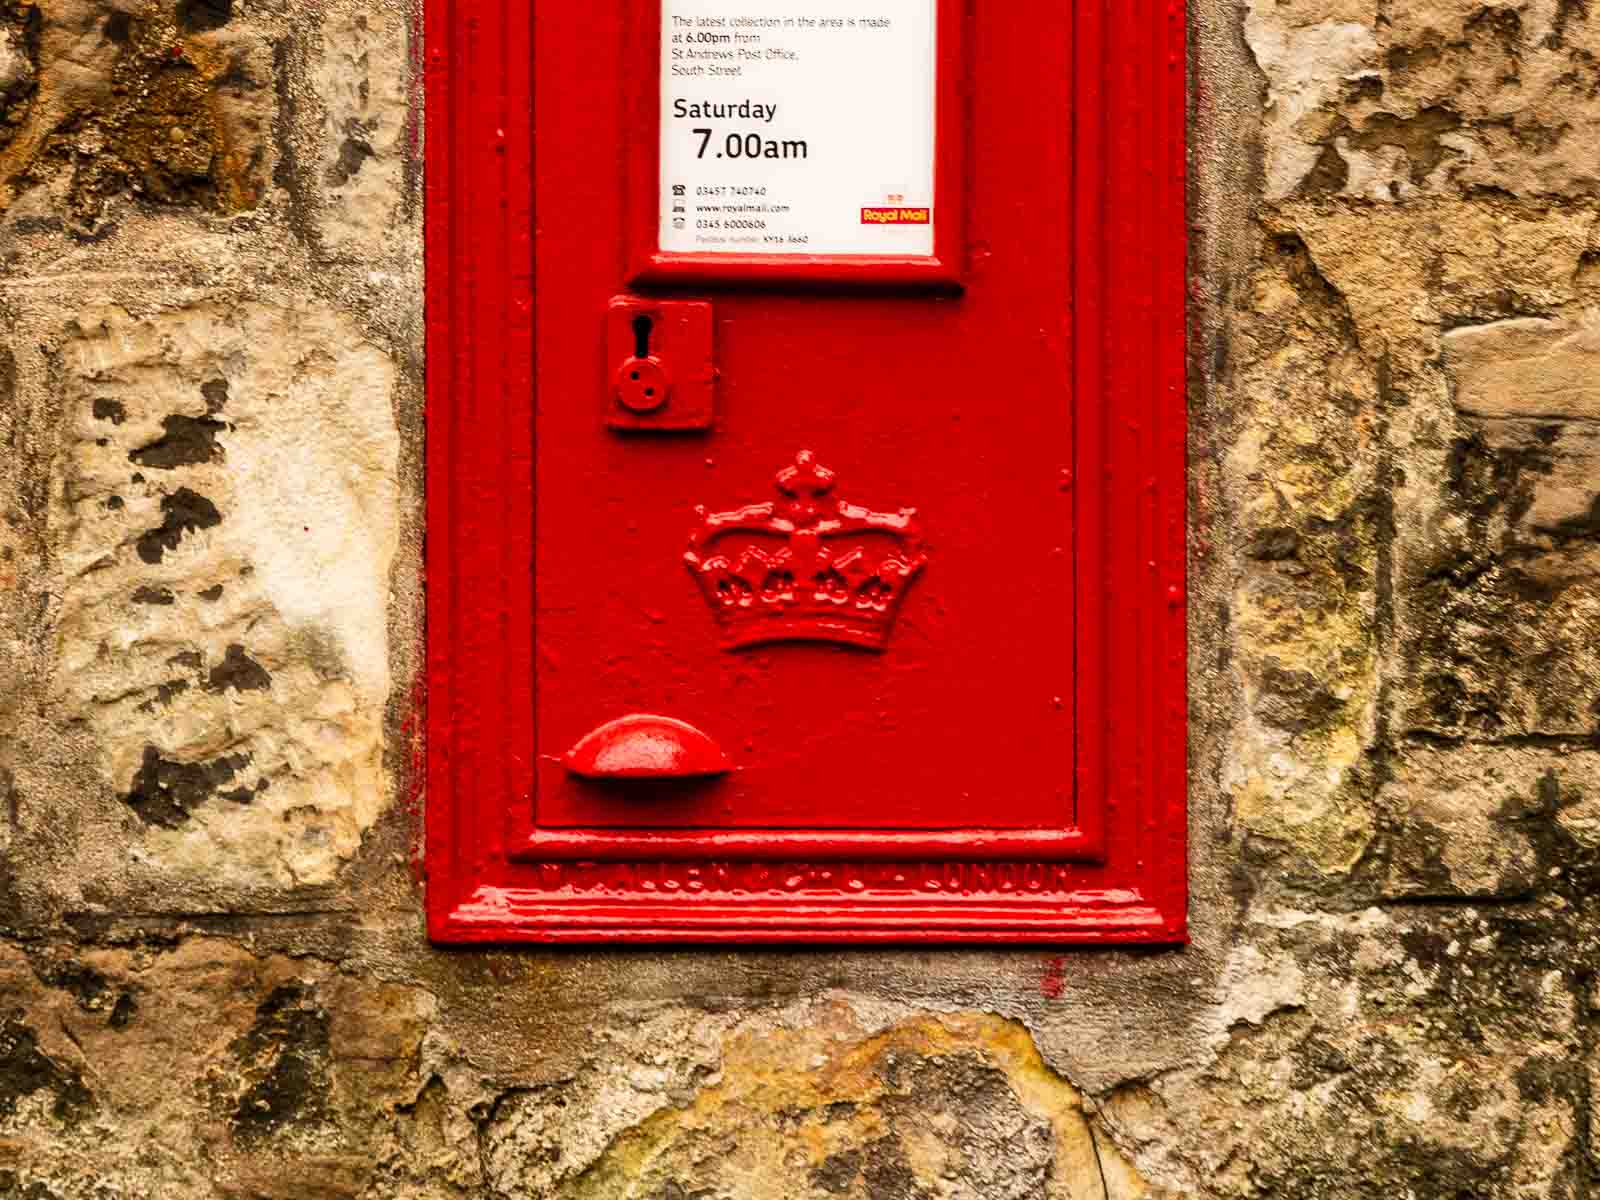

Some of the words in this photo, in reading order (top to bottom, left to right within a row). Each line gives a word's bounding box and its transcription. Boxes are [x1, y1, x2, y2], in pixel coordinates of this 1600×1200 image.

[672, 16, 693, 28] The
[696, 16, 726, 28] latest
[730, 16, 780, 28] collection
[783, 16, 794, 28] in
[798, 16, 816, 28] the
[819, 18, 843, 28] area
[859, 16, 890, 28] made
[672, 33, 683, 44] at
[686, 32, 731, 46] 6.00pm
[734, 32, 760, 44] from
[672, 48, 683, 60] St
[686, 48, 733, 60] Andrews
[737, 48, 762, 60] Post
[672, 64, 704, 76] South
[708, 64, 742, 76] Street
[673, 98, 777, 122] Saturday
[692, 128, 808, 159] 7.00am
[696, 203, 790, 214] www.royalmail.com
[863, 208, 898, 223] Royal
[899, 208, 928, 221] Mail
